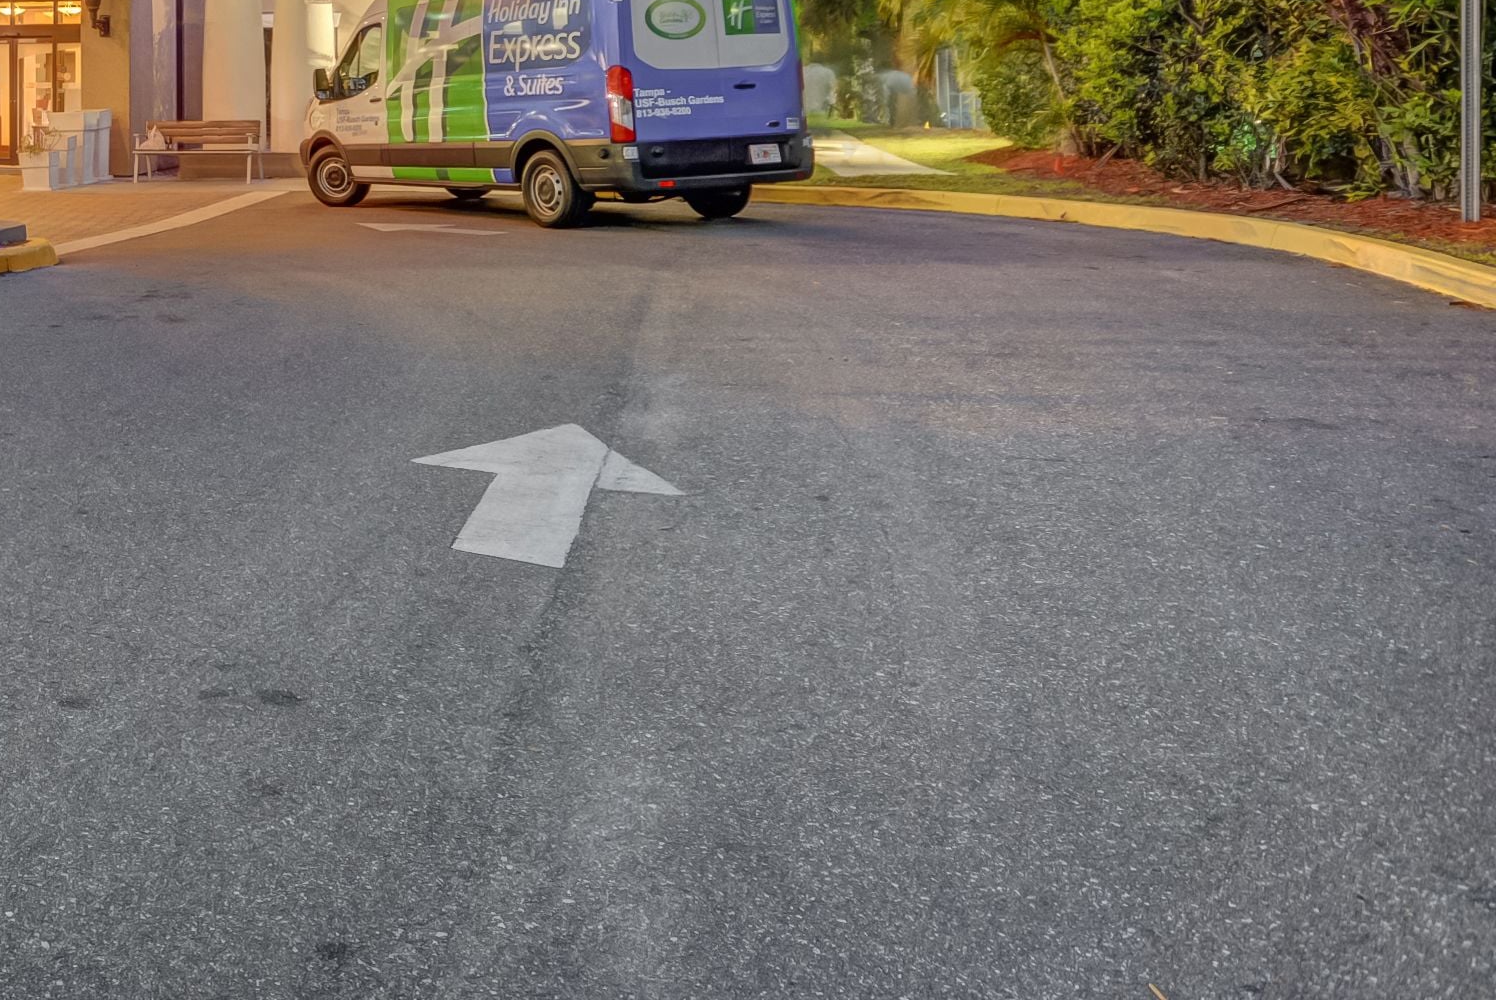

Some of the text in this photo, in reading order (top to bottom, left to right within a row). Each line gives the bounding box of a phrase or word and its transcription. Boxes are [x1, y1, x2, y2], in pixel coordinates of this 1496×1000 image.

[489, 29, 581, 73] Express
[503, 74, 564, 96] & Suites
[633, 88, 665, 98] Tampa
[635, 95, 724, 108] USF-Busch Gardens
